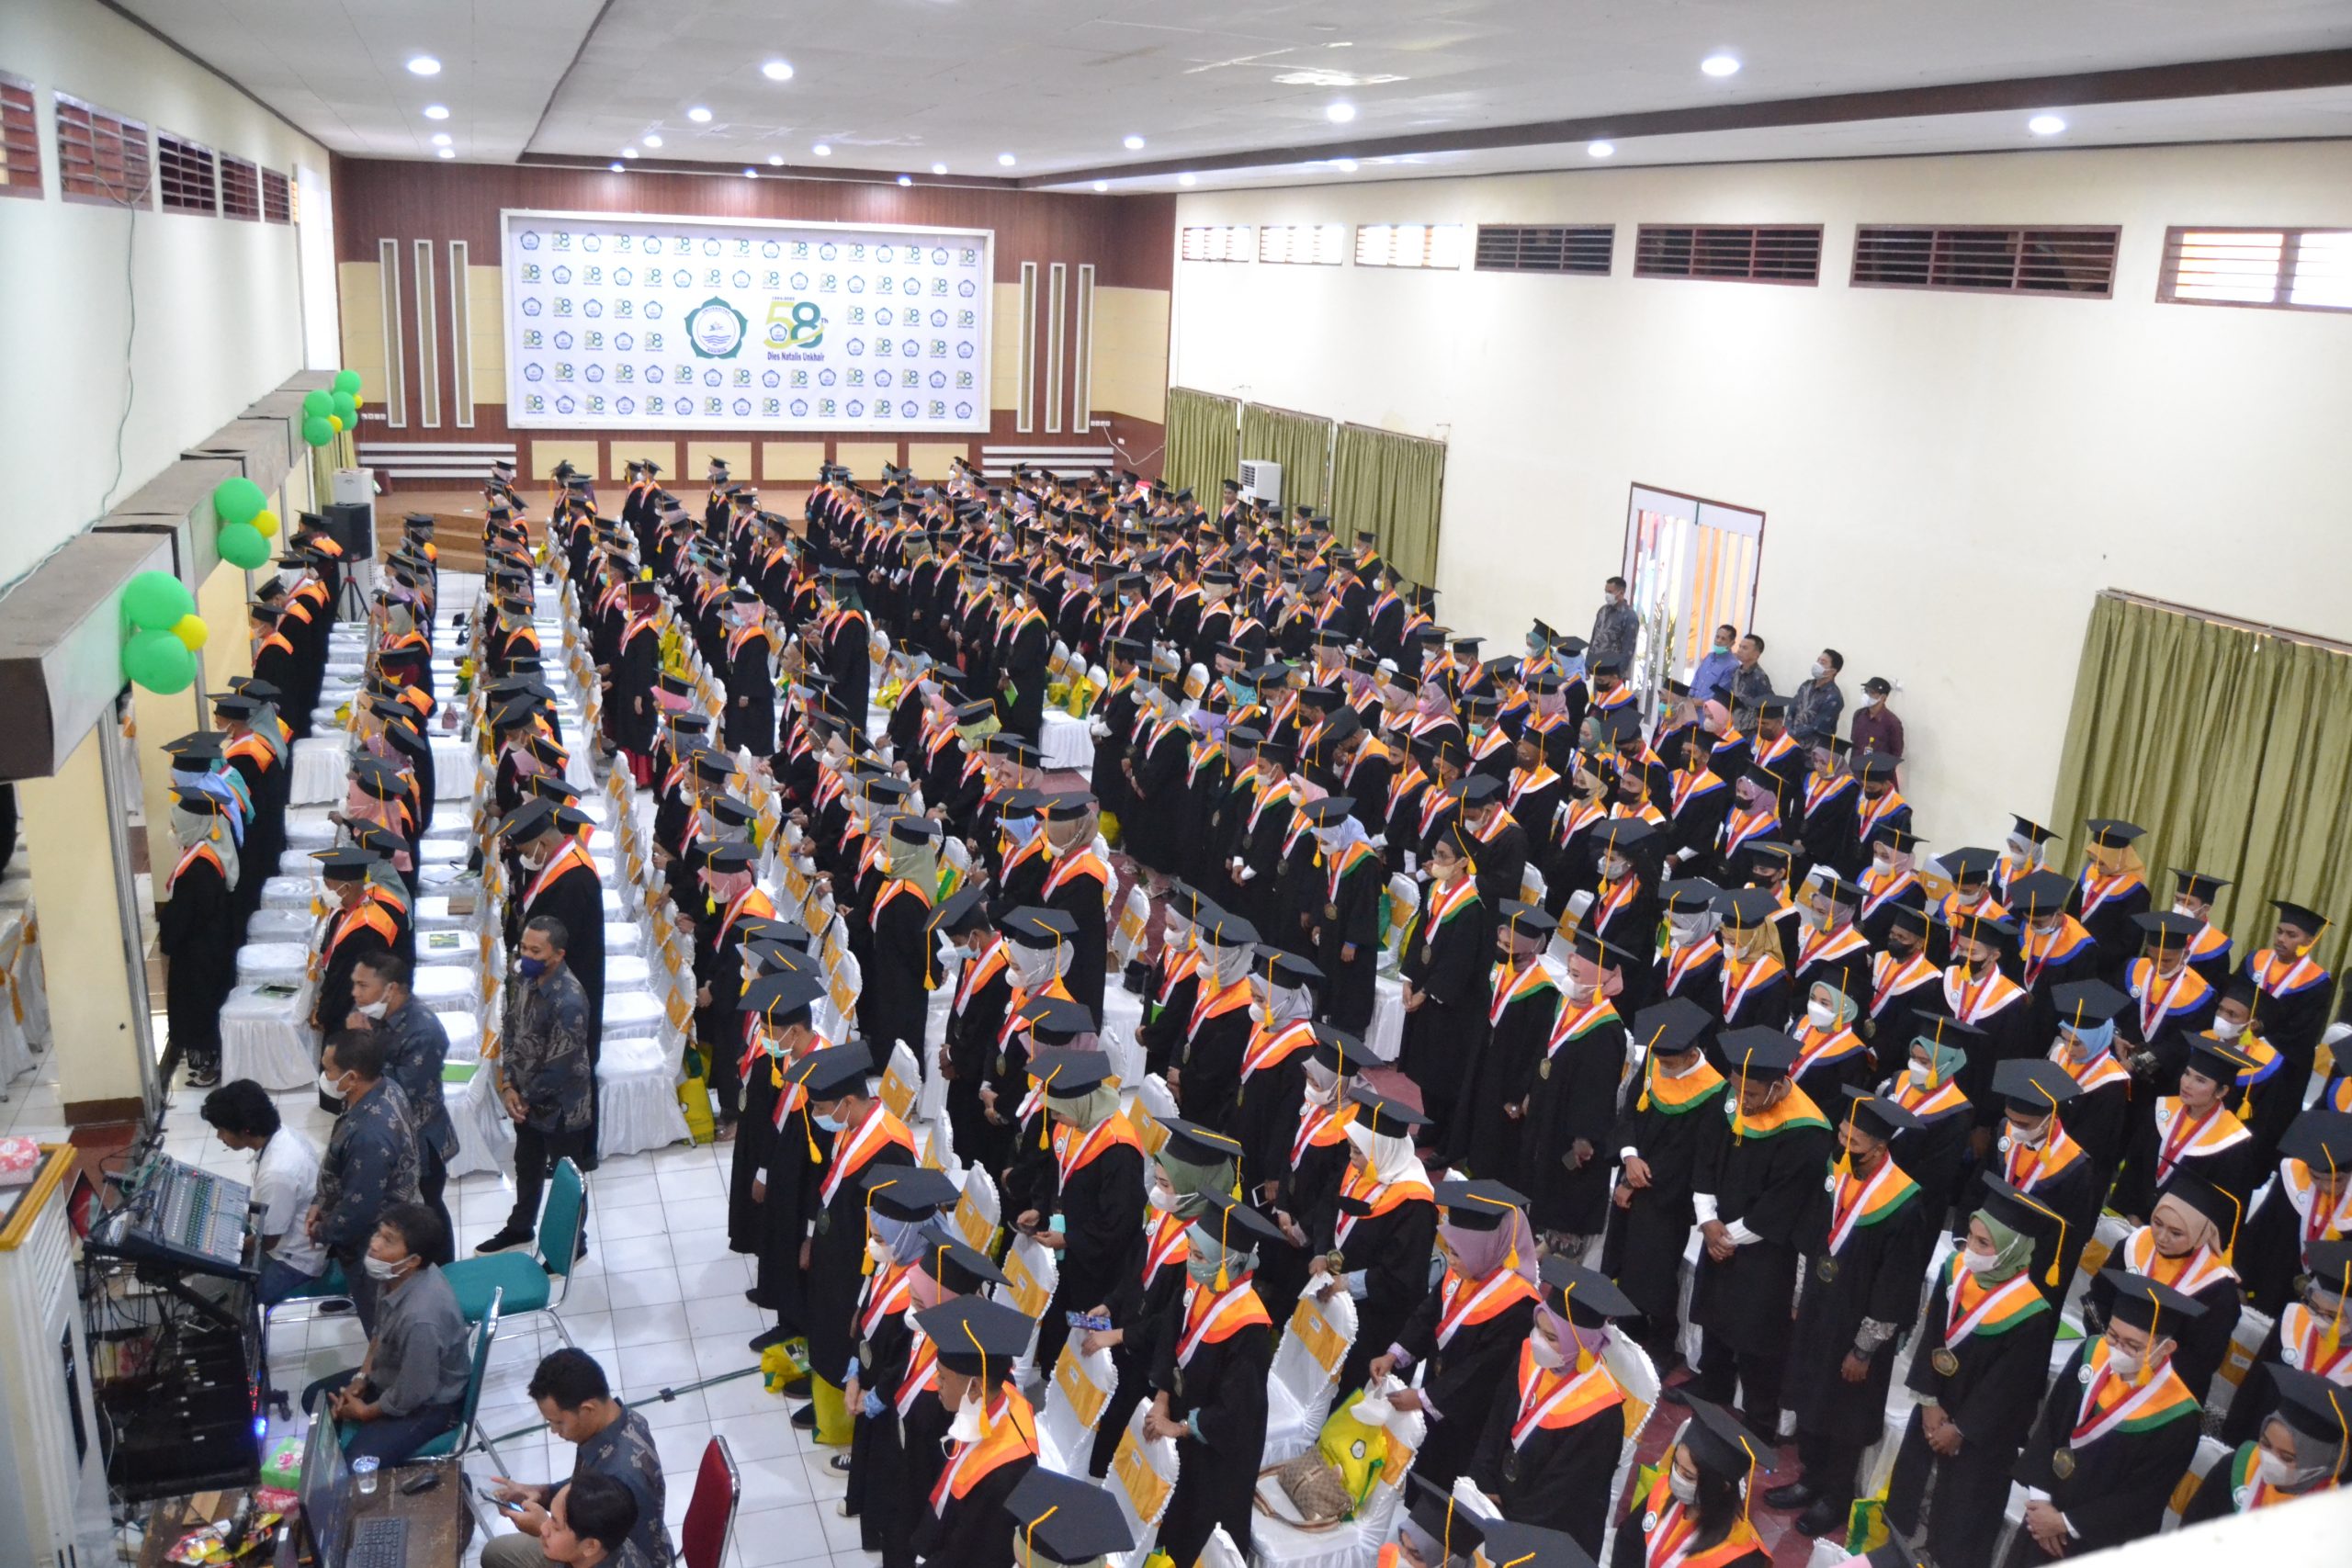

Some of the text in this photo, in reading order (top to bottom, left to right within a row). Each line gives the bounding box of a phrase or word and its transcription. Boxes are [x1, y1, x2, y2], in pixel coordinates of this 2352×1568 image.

[763, 301, 824, 348] 58
[767, 352, 825, 362] Dies Natalis Unkhair
